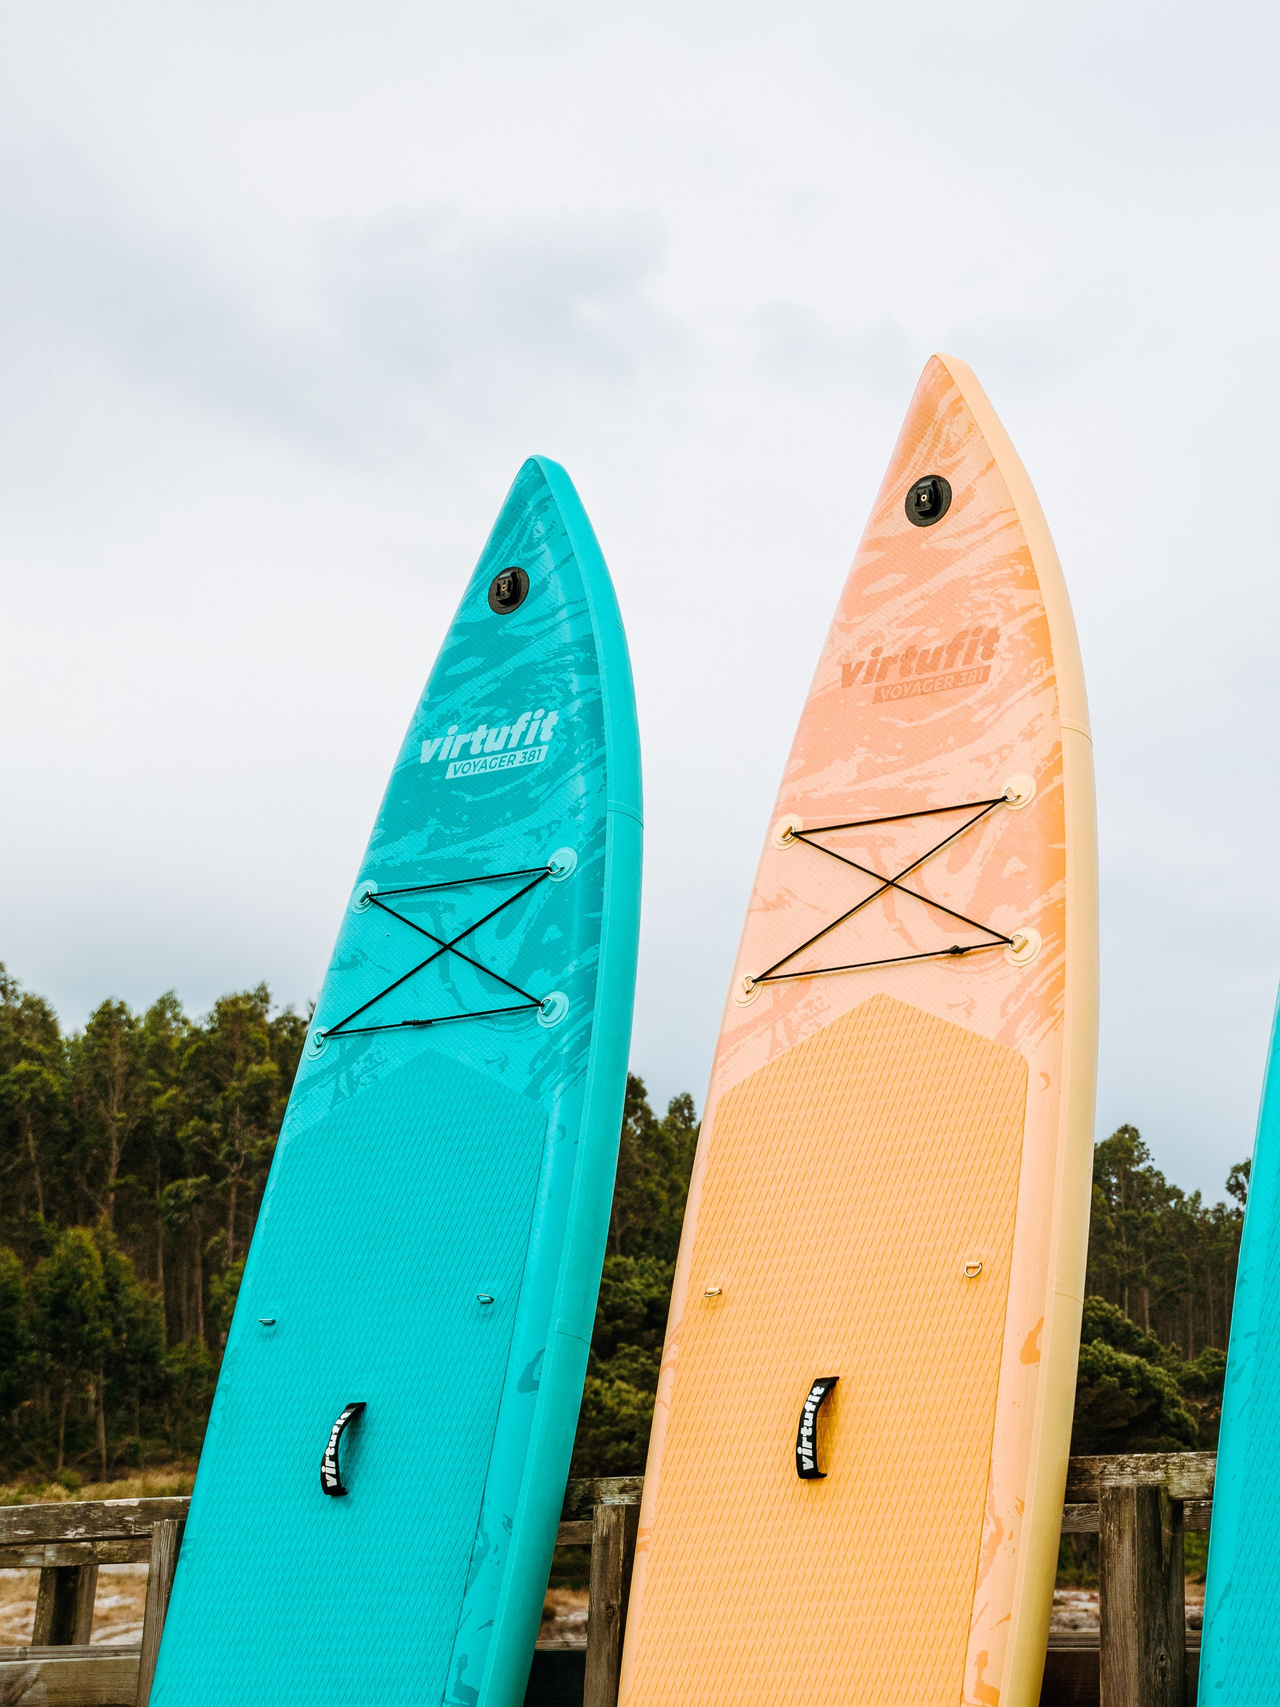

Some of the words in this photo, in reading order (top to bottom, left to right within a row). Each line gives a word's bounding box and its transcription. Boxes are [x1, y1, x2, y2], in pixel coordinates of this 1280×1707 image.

[841, 626, 1001, 688] virtufit
[881, 676, 954, 701] VOYAGER
[957, 669, 984, 686] 381
[420, 708, 560, 764] virtufit
[453, 754, 516, 776] VOYAGER
[518, 748, 542, 764] 381
[797, 1386, 825, 1470] virtufit
